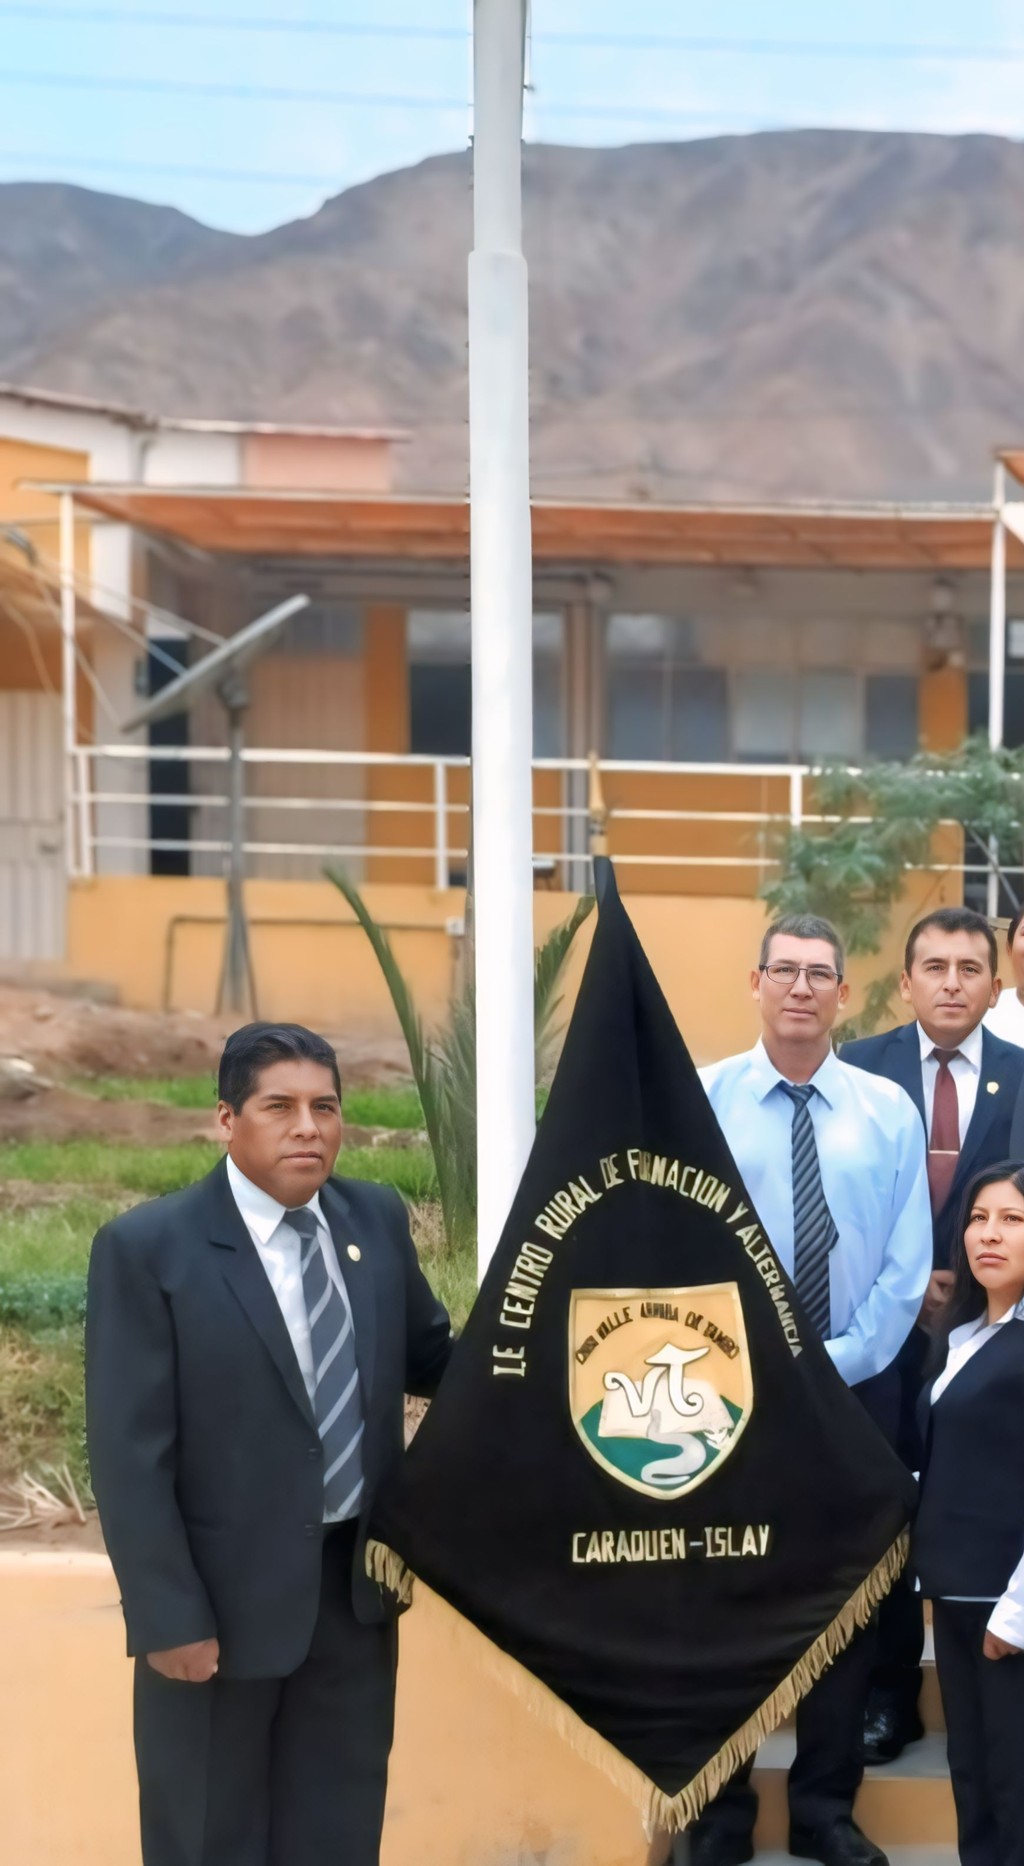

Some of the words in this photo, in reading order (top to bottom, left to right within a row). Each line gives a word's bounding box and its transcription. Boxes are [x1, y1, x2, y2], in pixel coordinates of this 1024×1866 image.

[499, 1241, 554, 1329] CENTRO
[534, 1175, 603, 1240] RURAL
[599, 1153, 625, 1189] DE
[726, 1201, 749, 1223] Y
